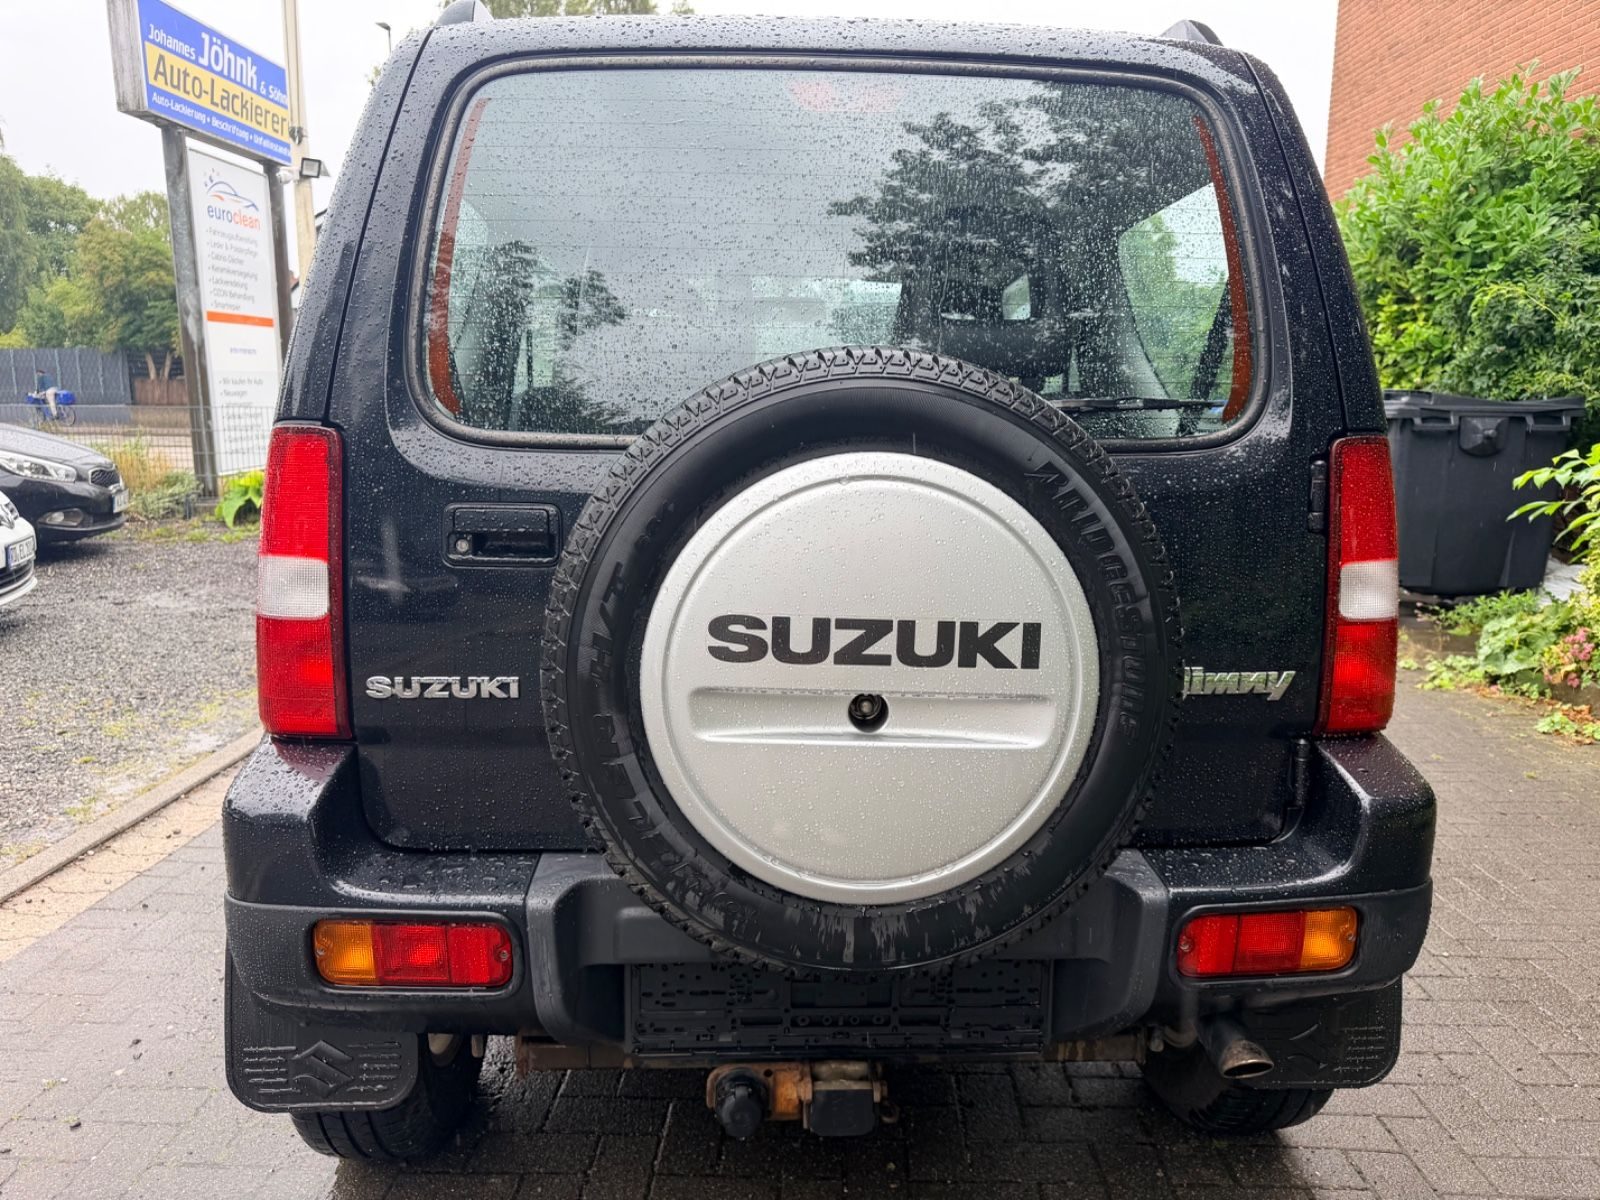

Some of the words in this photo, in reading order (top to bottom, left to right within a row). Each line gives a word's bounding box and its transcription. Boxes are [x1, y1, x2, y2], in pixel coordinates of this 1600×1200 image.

[148, 24, 195, 60] Johannes
[198, 32, 258, 91] Jöhnk
[260, 81, 266, 96] &
[152, 92, 206, 125] Auto-Lackierung
[207, 204, 260, 231] euroclean
[707, 613, 1042, 670] SUZUKI
[365, 675, 520, 699] SUZUKI
